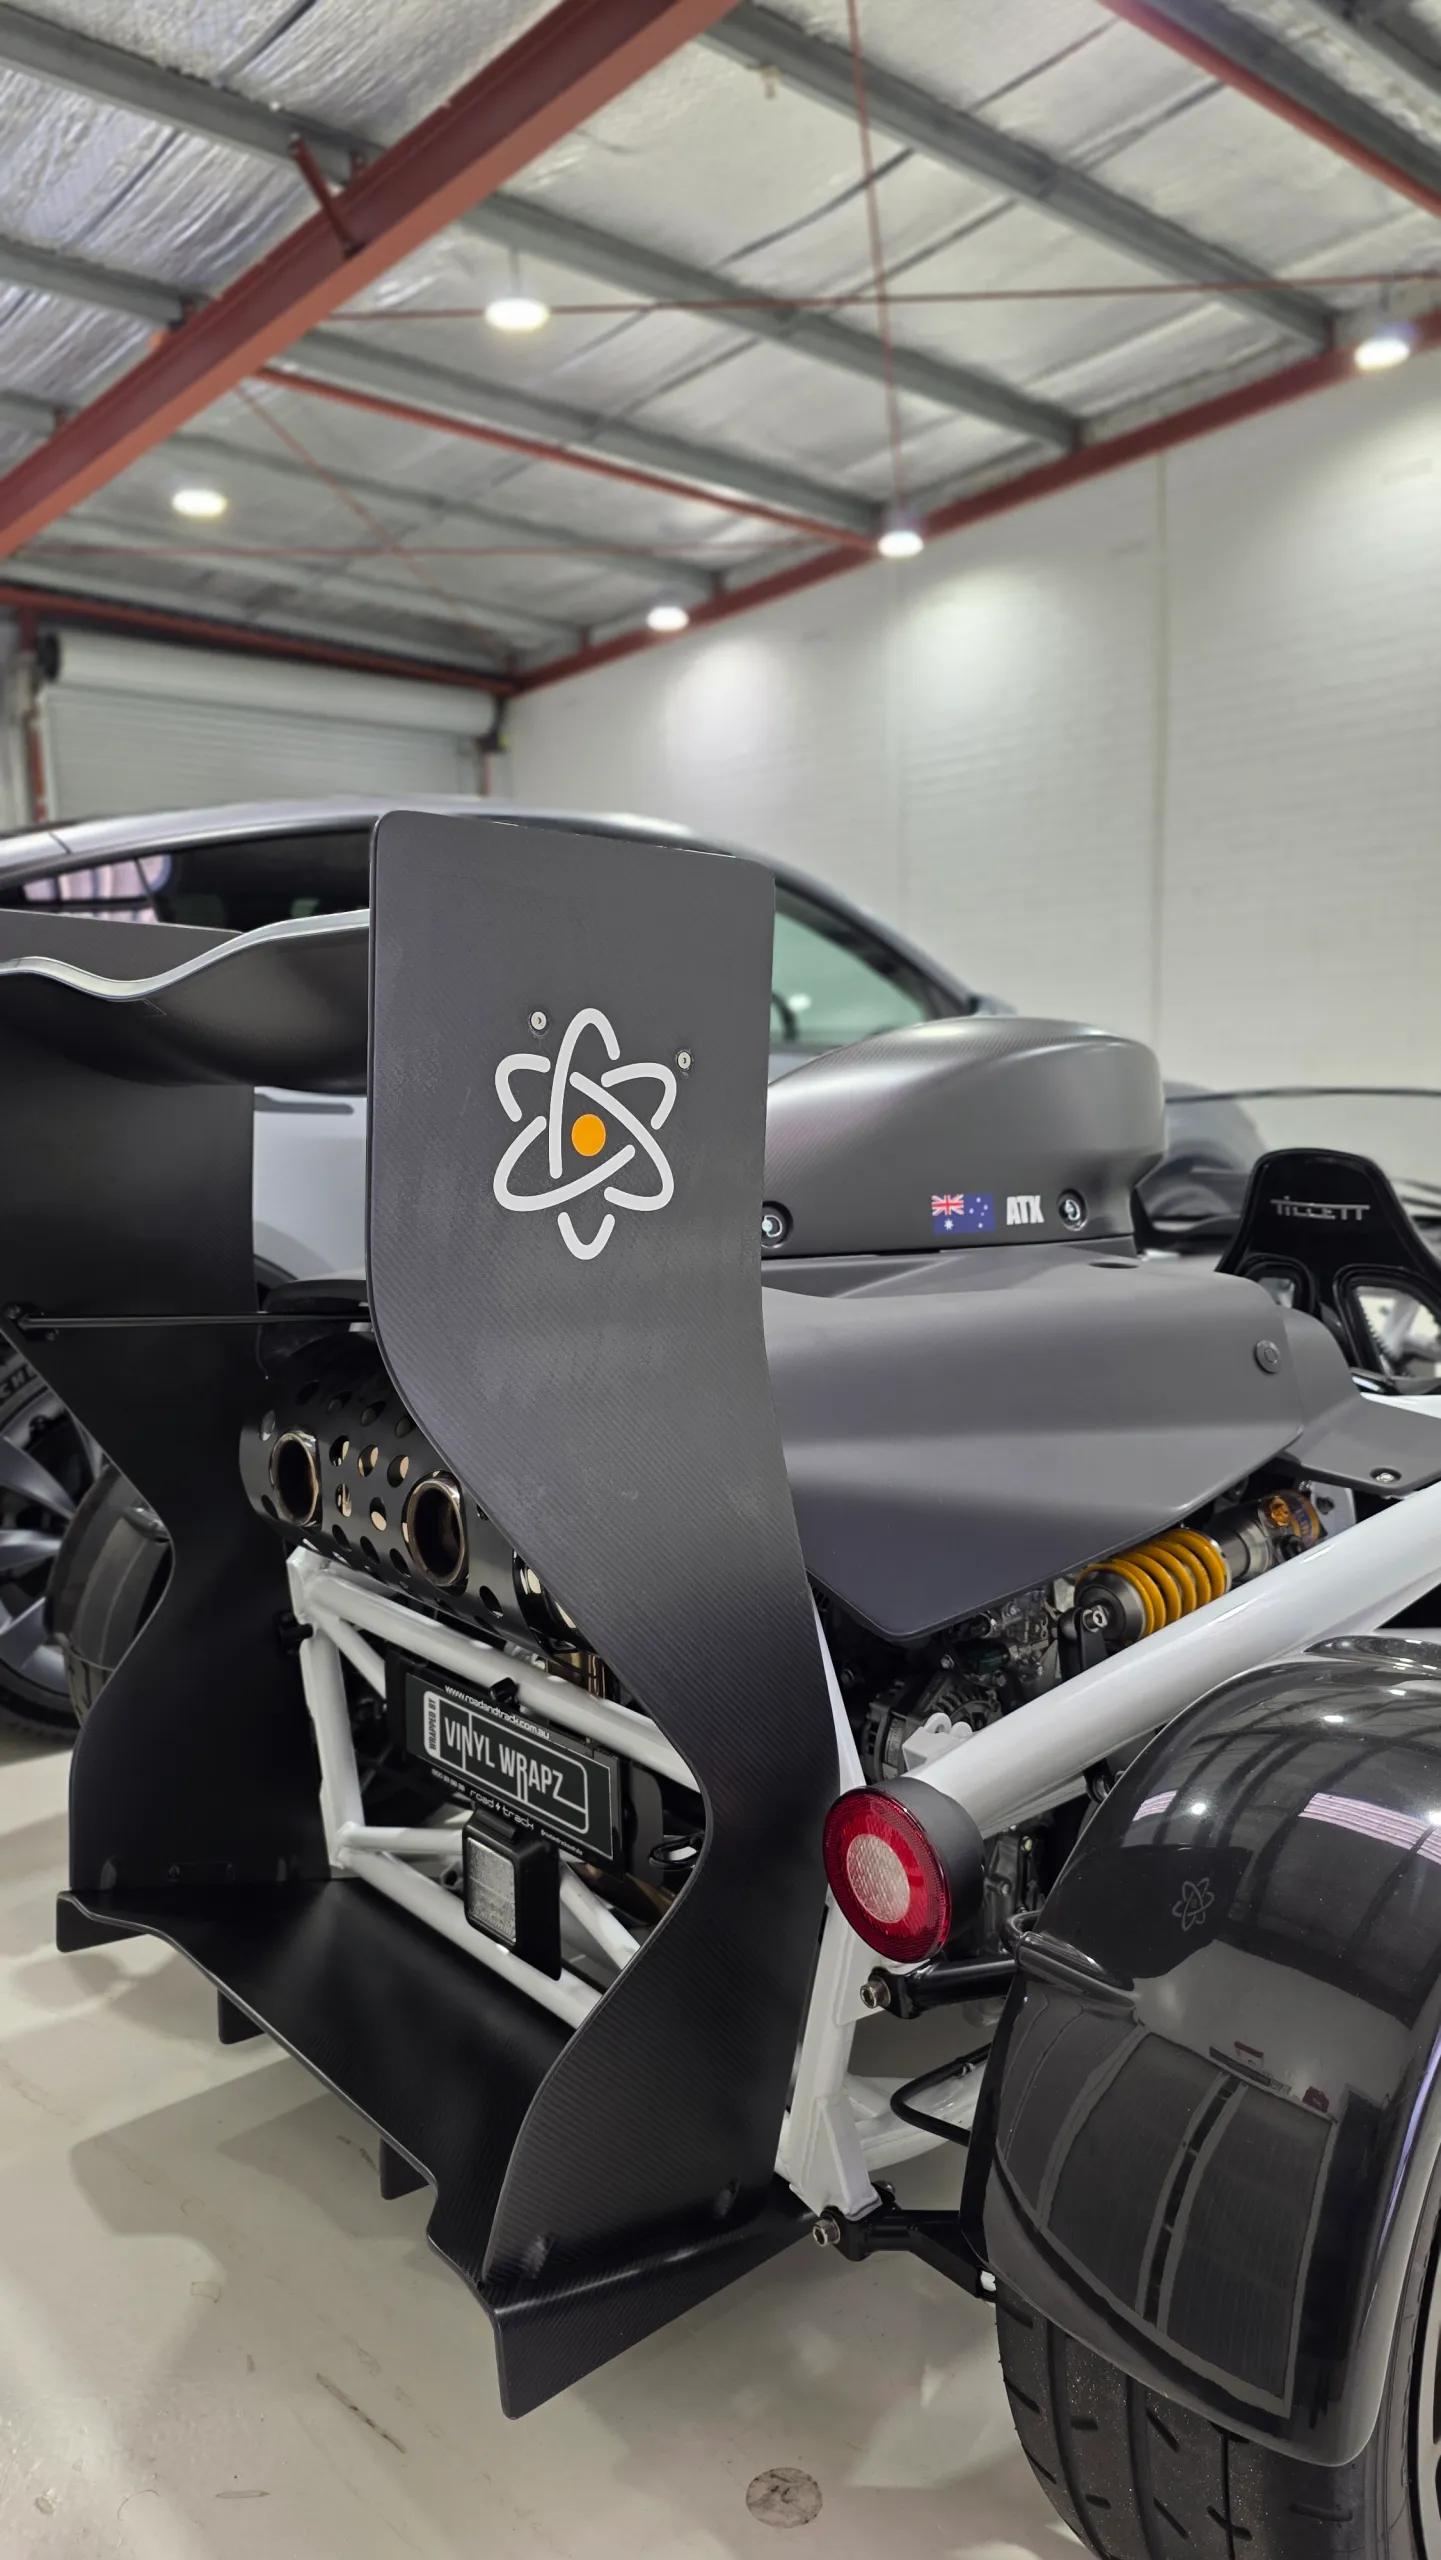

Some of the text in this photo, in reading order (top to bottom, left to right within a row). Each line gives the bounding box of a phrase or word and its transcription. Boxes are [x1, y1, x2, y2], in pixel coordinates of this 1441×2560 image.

[1006, 1195, 1044, 1225] ATX
[428, 1697, 437, 1751] WRAPPED BY
[445, 1685, 550, 1740] www.roadandtrack.com.au
[444, 1715, 495, 1770] VINYL
[499, 1743, 577, 1805] WRAPZ
[470, 1789, 495, 1809] road
[502, 1805, 534, 1831] track
